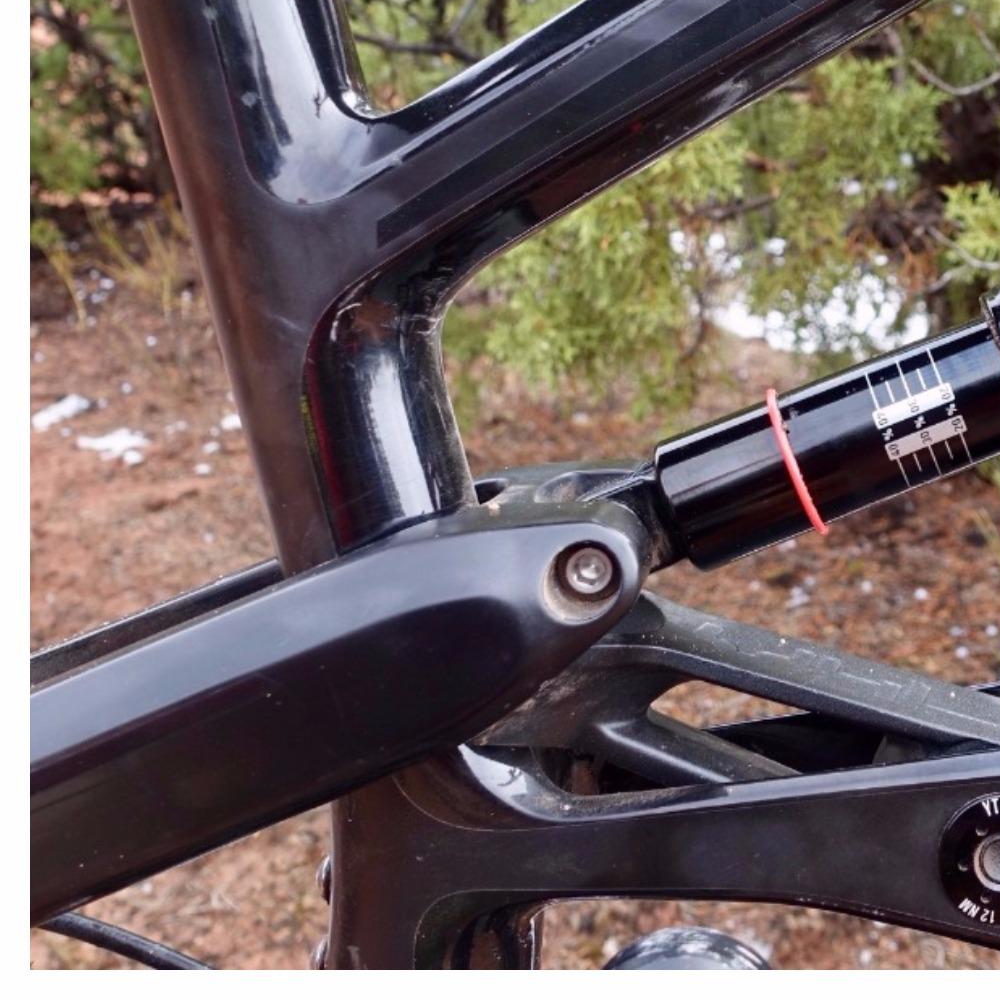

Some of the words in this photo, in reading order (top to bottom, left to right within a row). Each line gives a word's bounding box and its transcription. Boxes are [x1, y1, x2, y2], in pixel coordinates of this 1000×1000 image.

[981, 797, 1000, 818] YT
[957, 897, 979, 919] NM
[980, 907, 996, 925] 12
